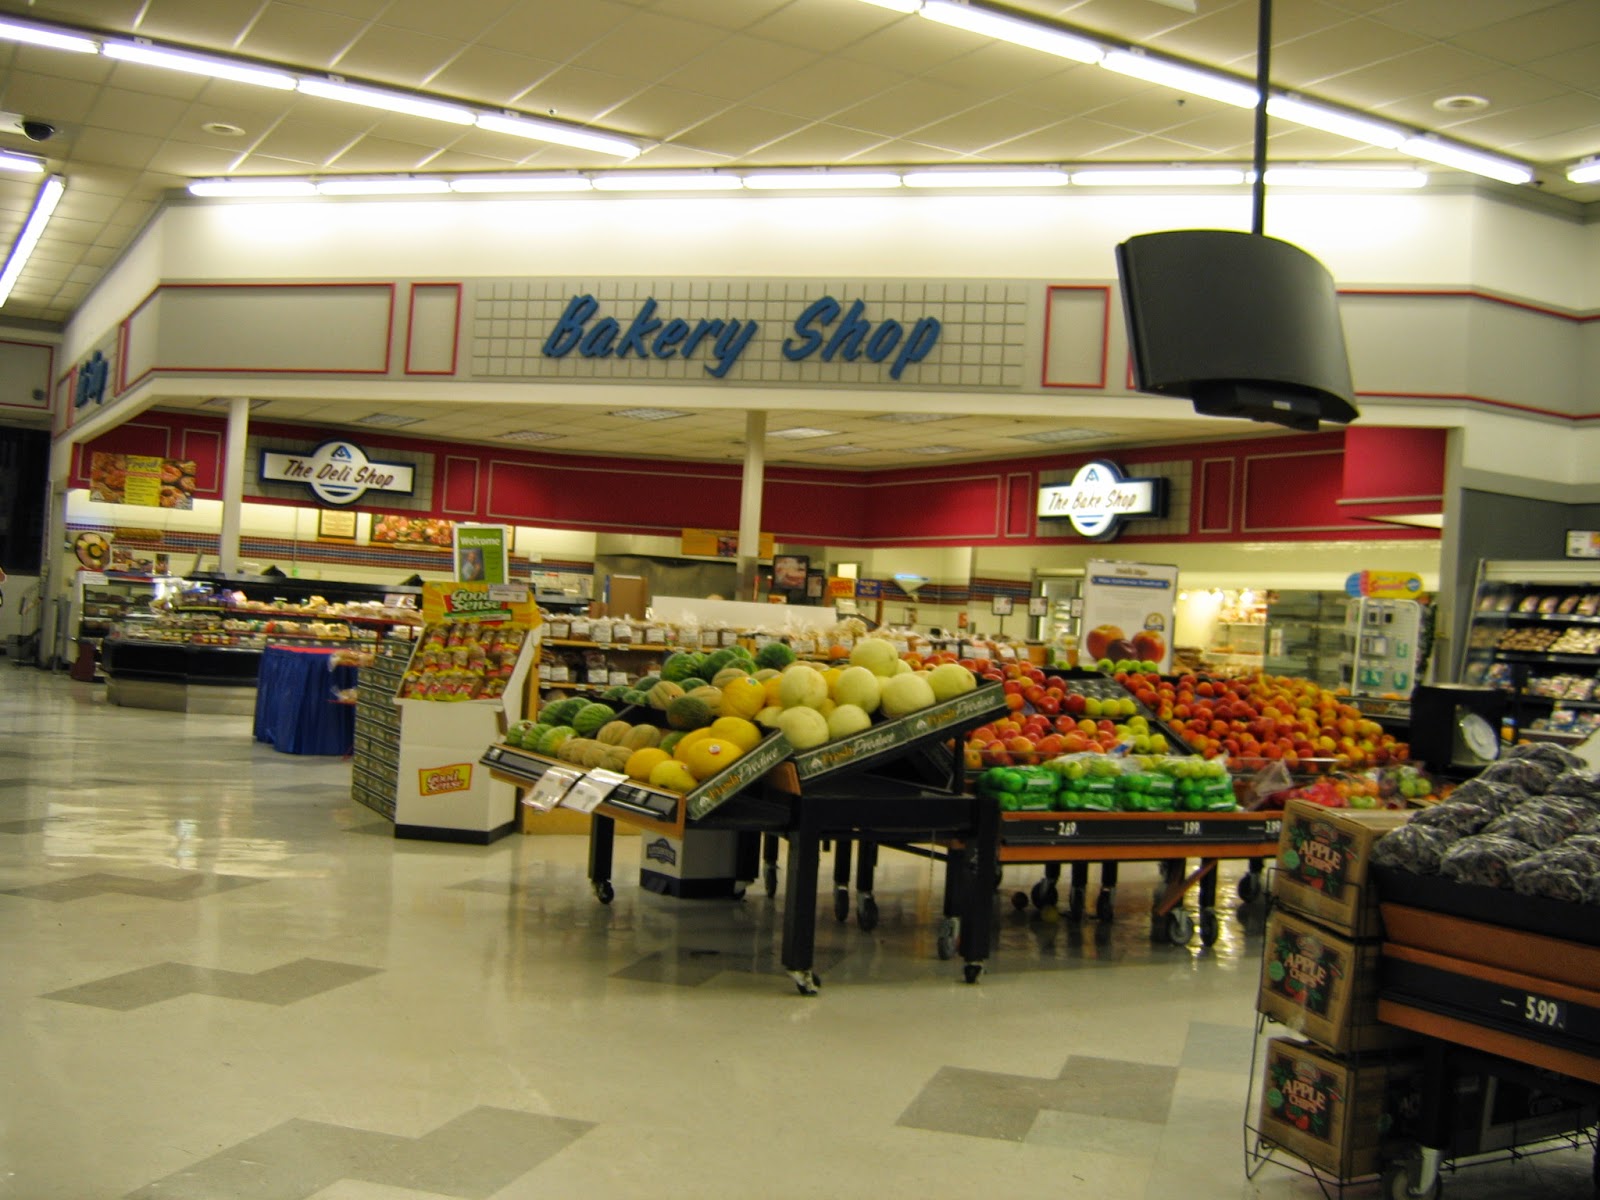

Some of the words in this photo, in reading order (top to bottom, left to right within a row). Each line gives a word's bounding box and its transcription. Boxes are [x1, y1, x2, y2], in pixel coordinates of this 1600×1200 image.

[541, 293, 758, 379] Bakery
[781, 295, 941, 380] Shop
[284, 459, 313, 478] The
[316, 463, 352, 482] Deli
[354, 466, 395, 488] Shop
[1048, 492, 1069, 510] The
[1071, 491, 1102, 510] Bake
[1105, 488, 1137, 511] Shop
[460, 536, 501, 546] Welcome
[451, 600, 502, 612] Sense
[427, 769, 460, 784] Good
[1299, 840, 1343, 870] APPLE
[1284, 952, 1327, 986] APPLE
[1282, 1079, 1327, 1112] APPLE
